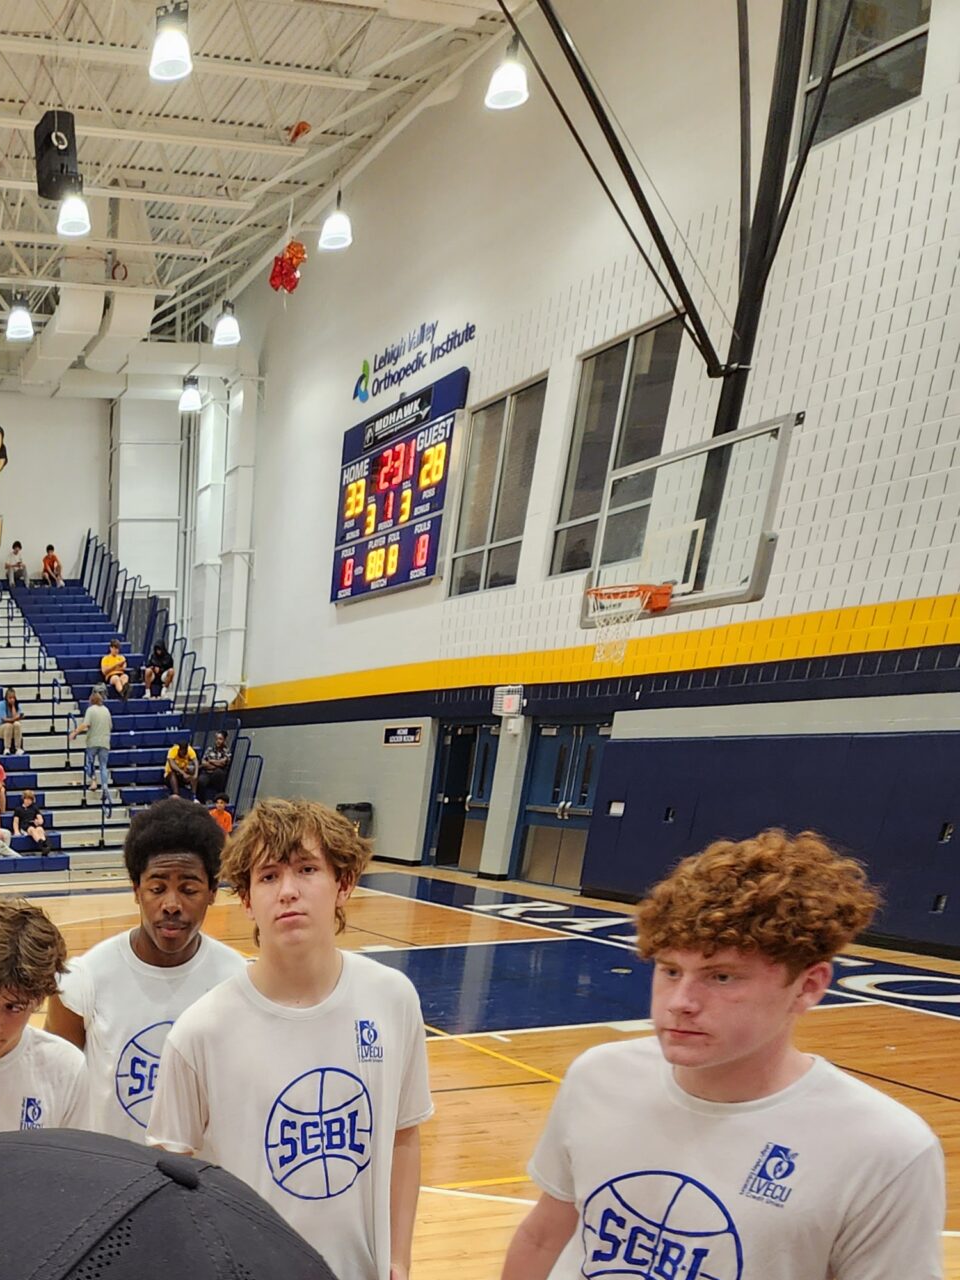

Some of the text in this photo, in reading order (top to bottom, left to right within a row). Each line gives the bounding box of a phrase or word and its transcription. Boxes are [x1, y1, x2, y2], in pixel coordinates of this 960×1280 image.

[372, 322, 476, 397] Orthopedic Institute
[373, 320, 438, 373] Lehigh Valley
[375, 398, 421, 432] MOHAWK
[417, 417, 454, 451] GUEST
[343, 458, 370, 485] HOME
[365, 503, 377, 535] 3
[399, 488, 412, 523] 3
[414, 520, 431, 534] FOULS
[361, 1046, 383, 1059] LVECU
[280, 1110, 365, 1168] SCBL
[749, 1177, 792, 1202] LVECU
